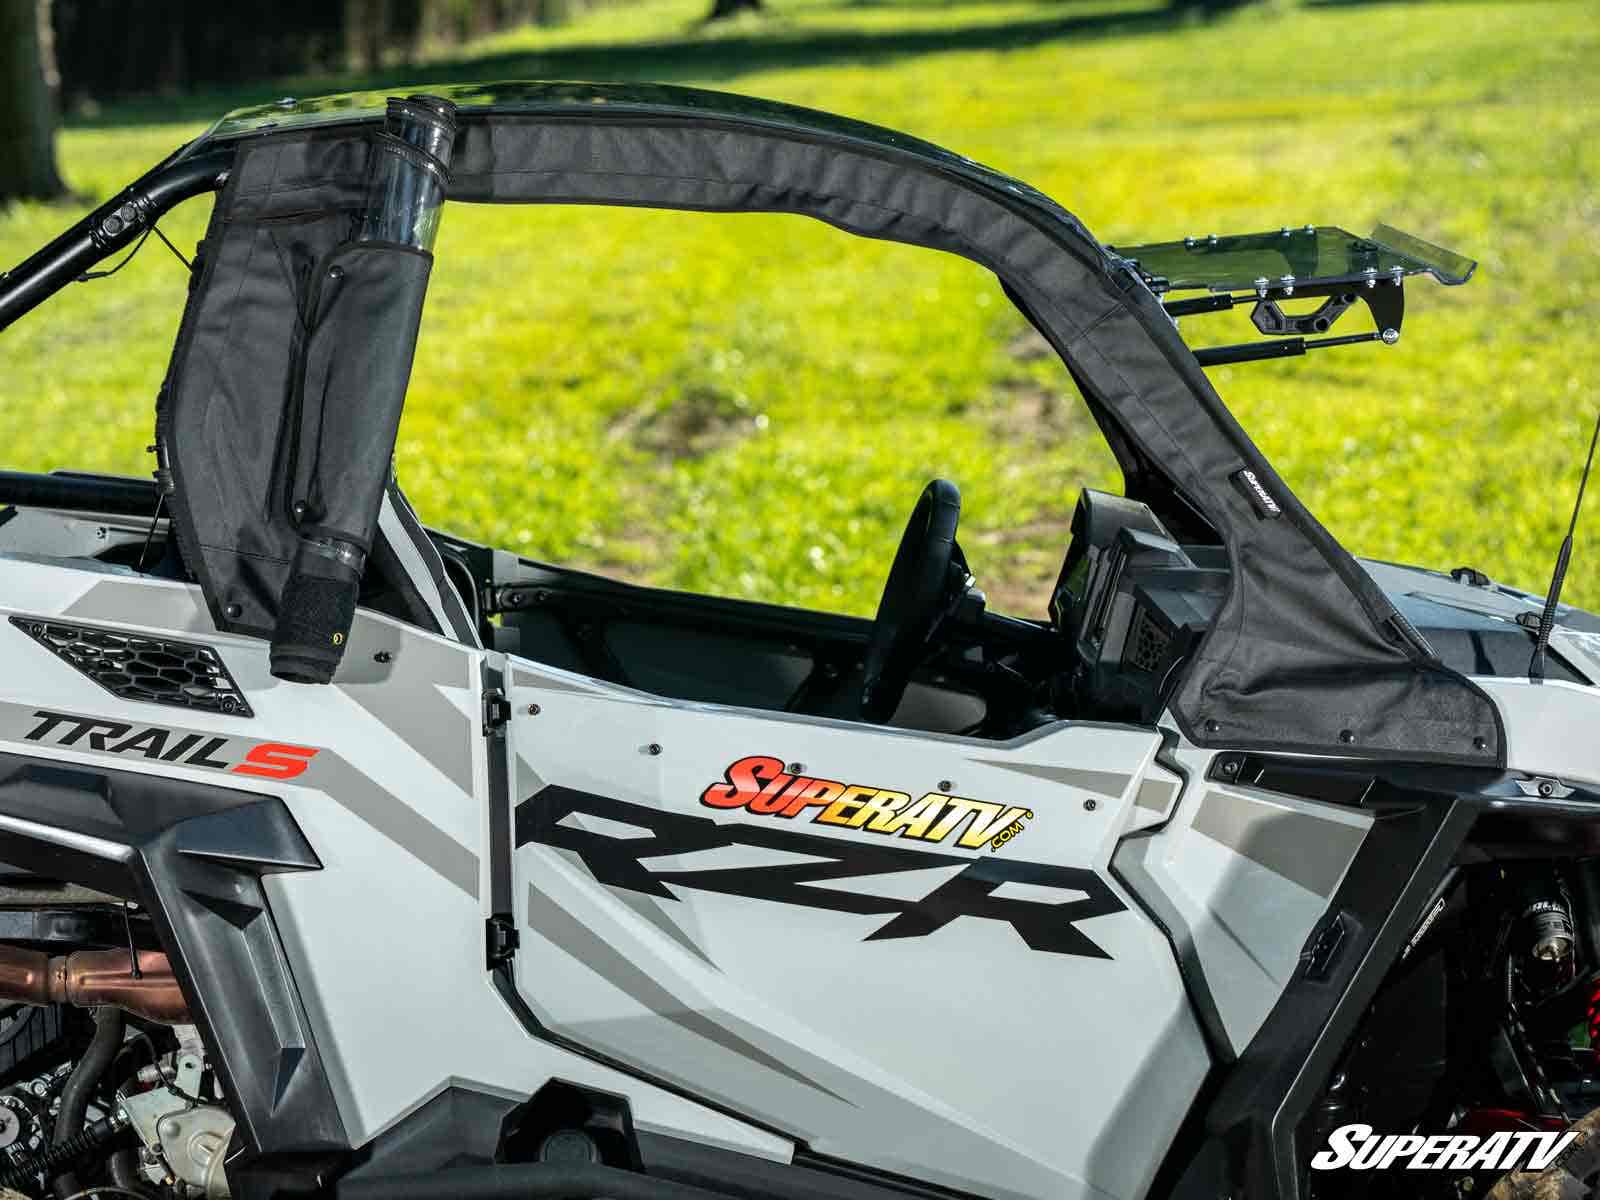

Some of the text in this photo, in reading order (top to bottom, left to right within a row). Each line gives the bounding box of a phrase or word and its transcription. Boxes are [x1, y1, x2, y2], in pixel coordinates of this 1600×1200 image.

[24, 710, 320, 780] TRAIL S
[515, 784, 1129, 960] RZR
